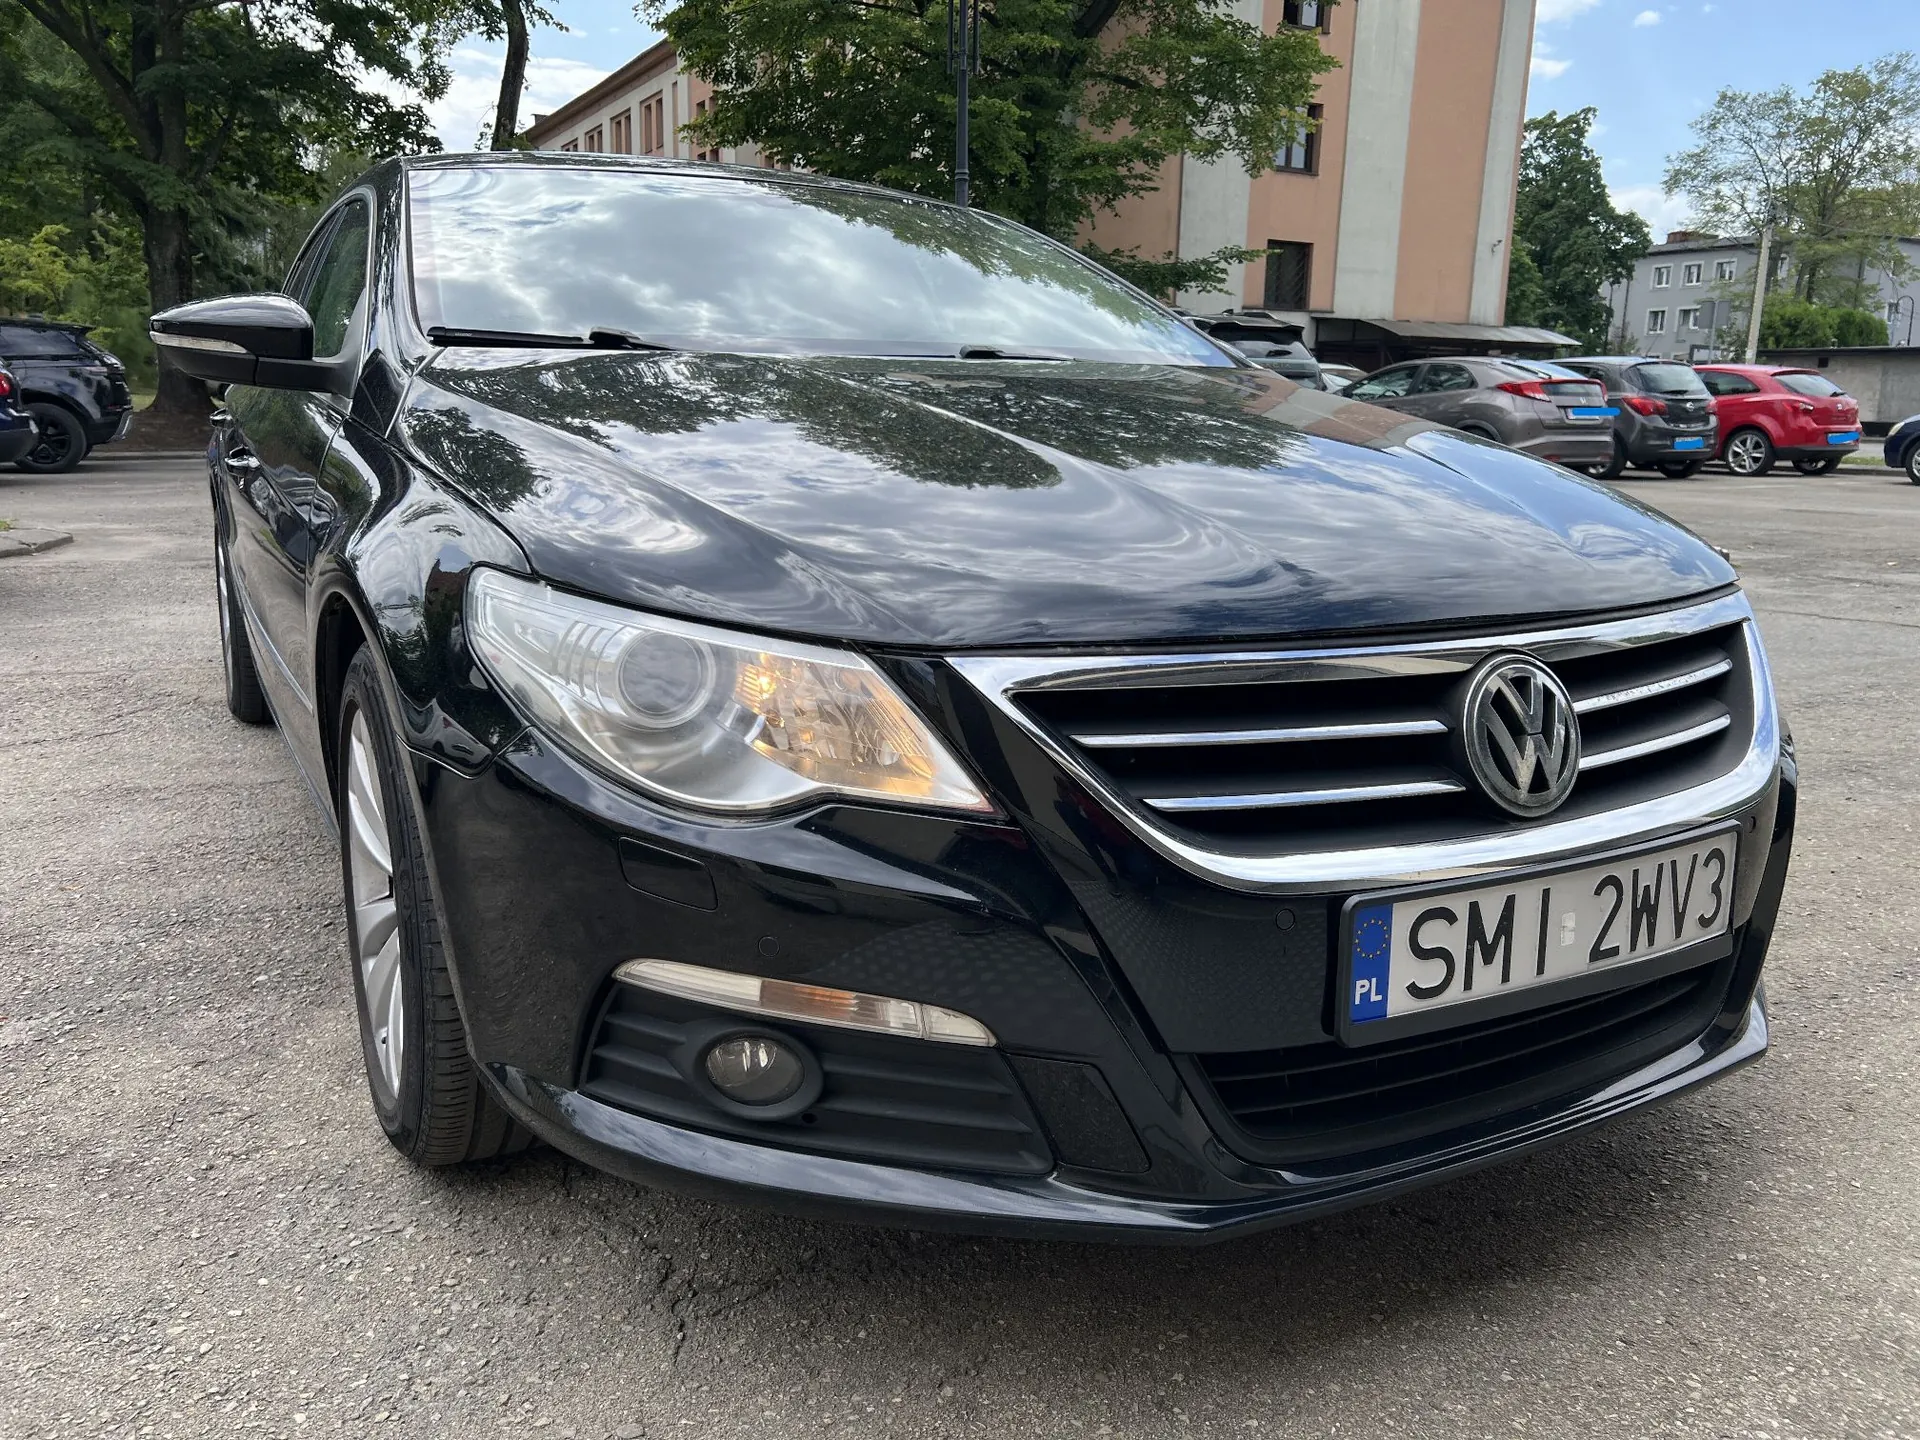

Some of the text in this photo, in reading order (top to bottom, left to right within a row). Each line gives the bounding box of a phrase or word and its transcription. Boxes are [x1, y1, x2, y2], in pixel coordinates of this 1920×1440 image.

[1406, 847, 1726, 1000] SMI 2WV3
[1354, 977, 1383, 1005] PL
